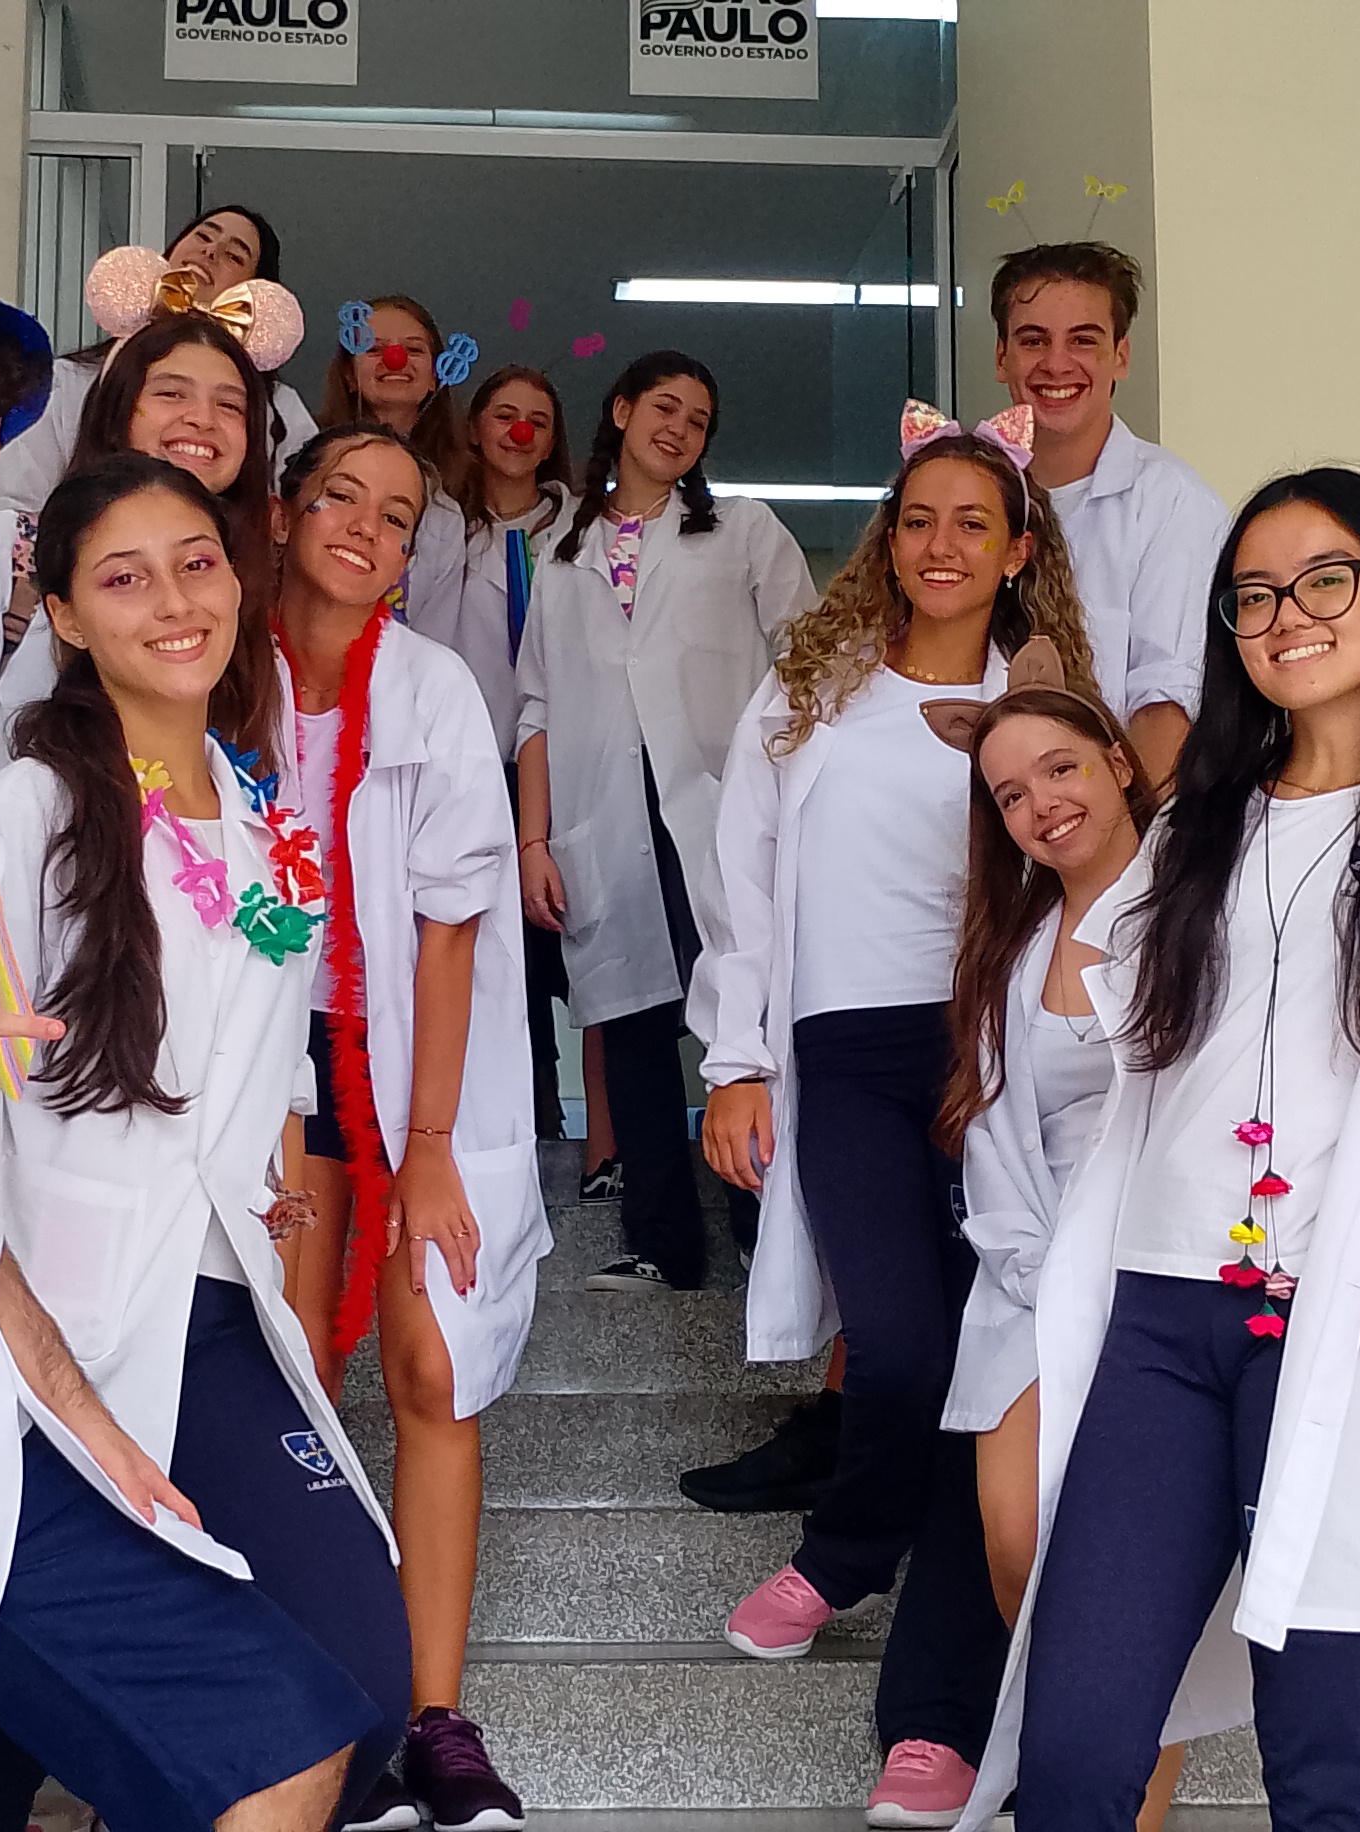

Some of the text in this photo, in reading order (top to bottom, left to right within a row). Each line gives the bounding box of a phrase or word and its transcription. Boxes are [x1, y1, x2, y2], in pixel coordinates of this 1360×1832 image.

[176, 0, 347, 29] PAULO
[640, 7, 807, 44] PAULO
[176, 28, 348, 45] GOVERNO DO ESTADO
[640, 44, 808, 60] GOVERNO DO ESTADO
